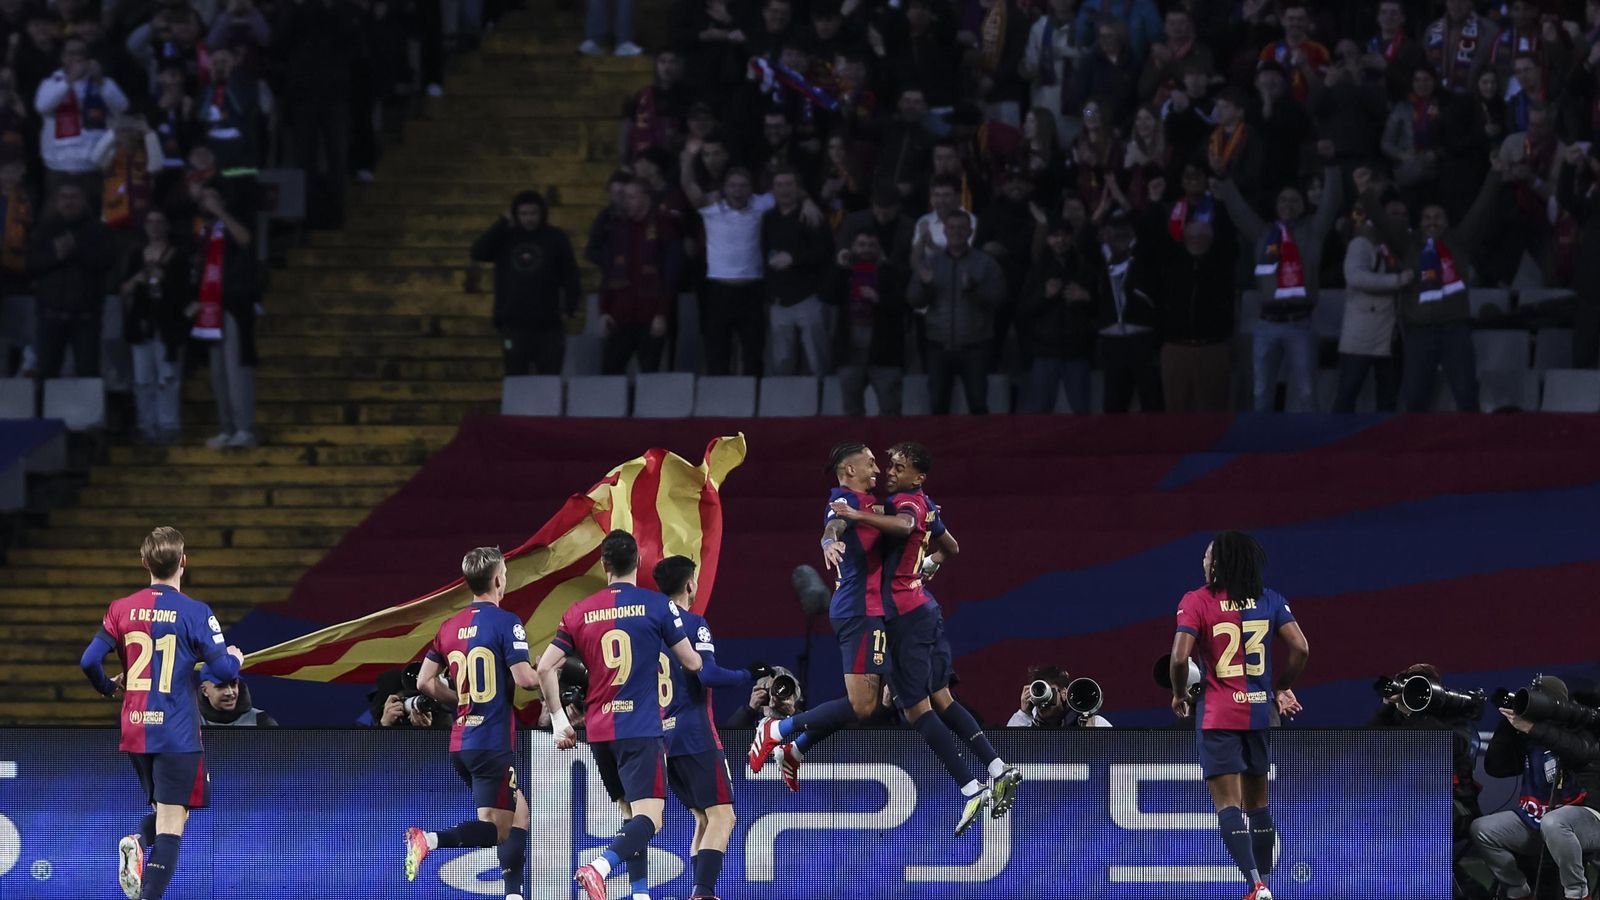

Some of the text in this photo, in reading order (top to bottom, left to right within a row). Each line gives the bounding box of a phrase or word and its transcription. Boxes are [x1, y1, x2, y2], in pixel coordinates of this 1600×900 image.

[458, 625, 478, 640] OLMO
[584, 605, 645, 624] LEWANDOWSKI
[873, 629, 887, 654] 11
[124, 631, 177, 693] 21
[447, 646, 497, 706] 20
[601, 629, 633, 686] 9
[1212, 619, 1269, 678] 23
